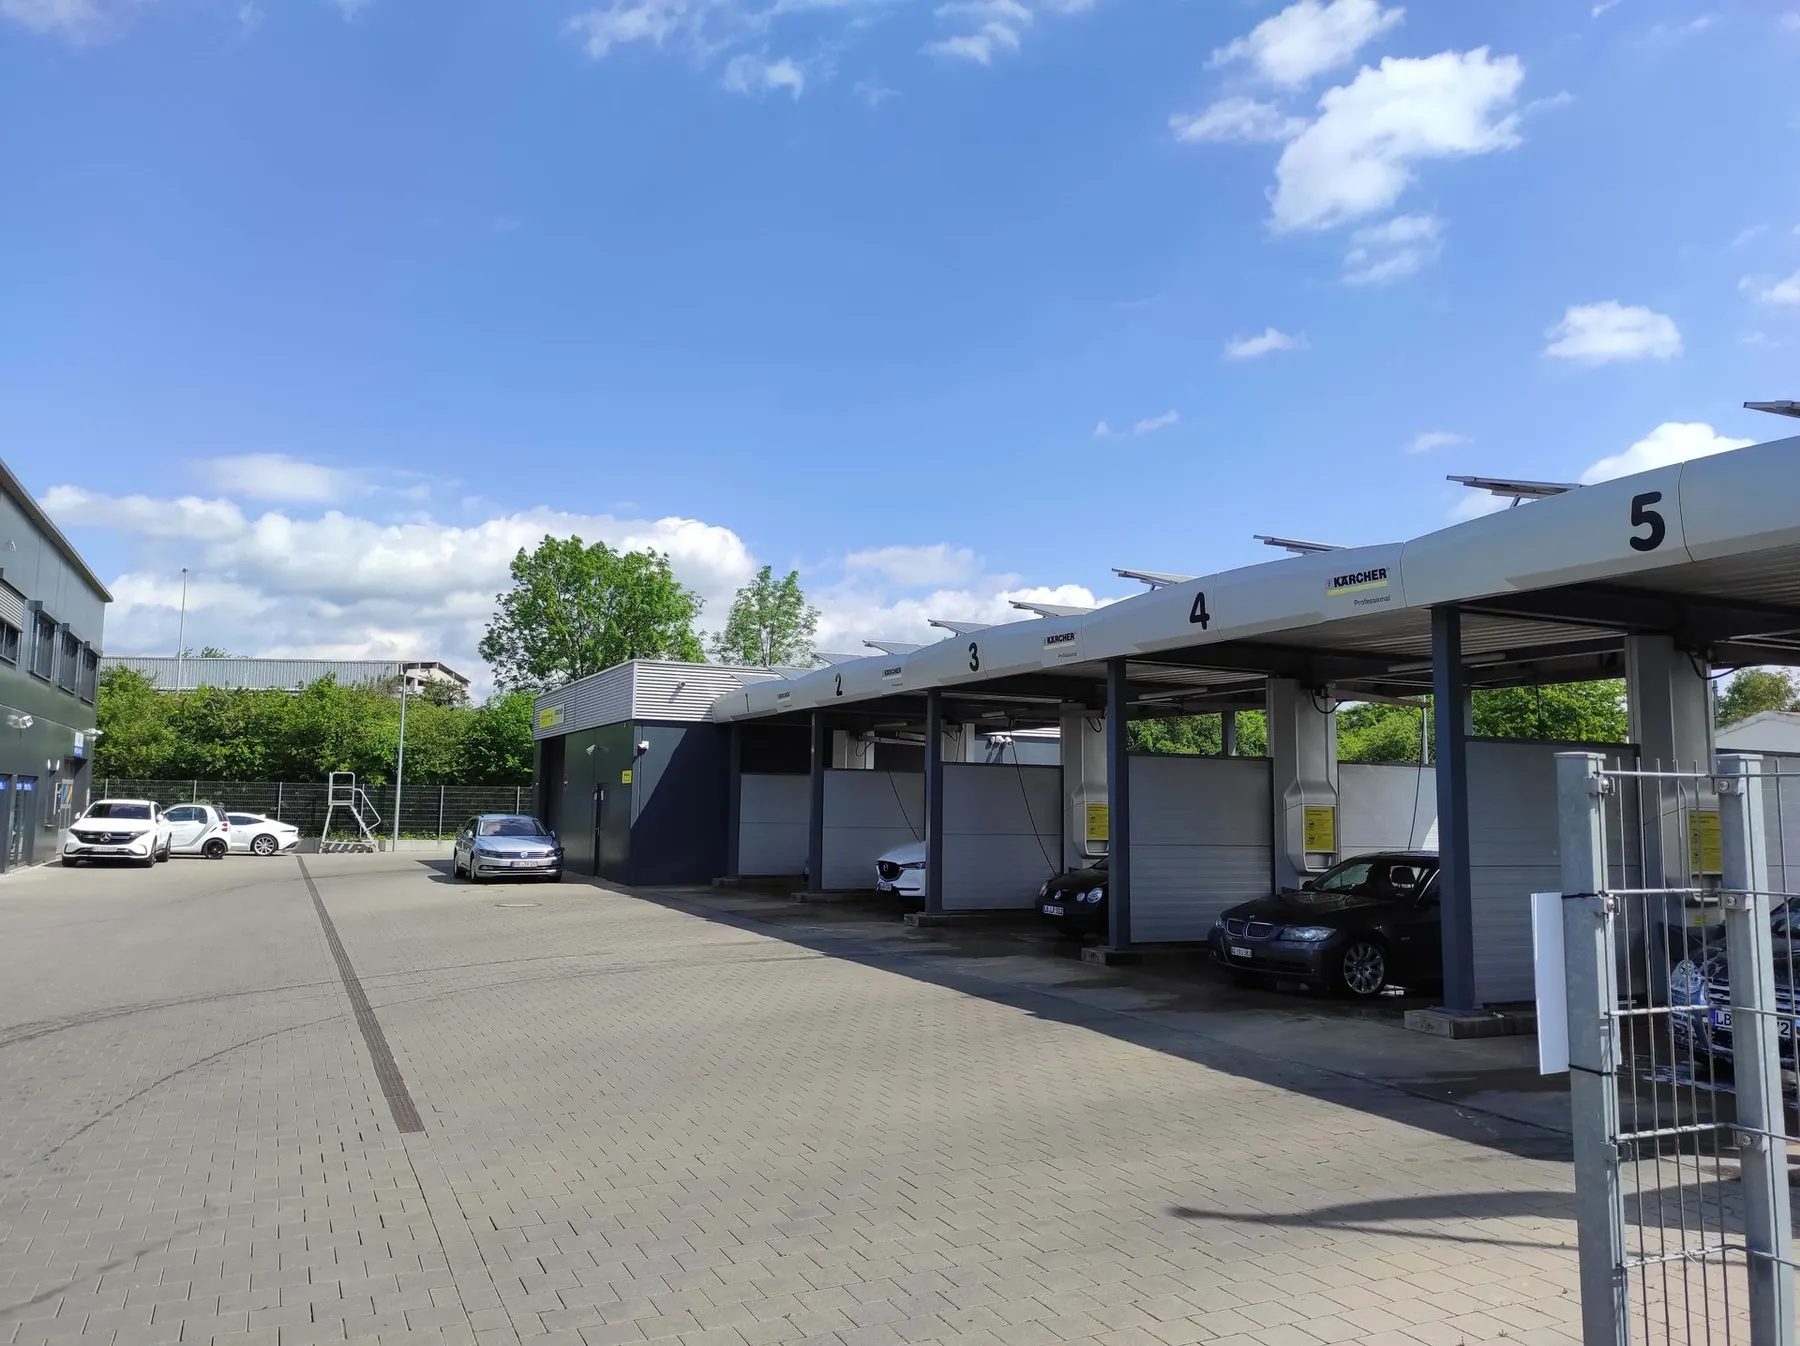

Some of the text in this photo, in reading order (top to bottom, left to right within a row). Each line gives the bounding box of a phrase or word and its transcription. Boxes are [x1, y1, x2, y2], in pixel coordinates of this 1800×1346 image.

[1629, 491, 1666, 552] 5
[1333, 567, 1388, 588] KÄRCHER
[1189, 591, 1210, 631] 4
[1353, 594, 1391, 606] Professional
[968, 642, 980, 672] 3
[835, 673, 843, 697] 2
[745, 693, 750, 712] 1
